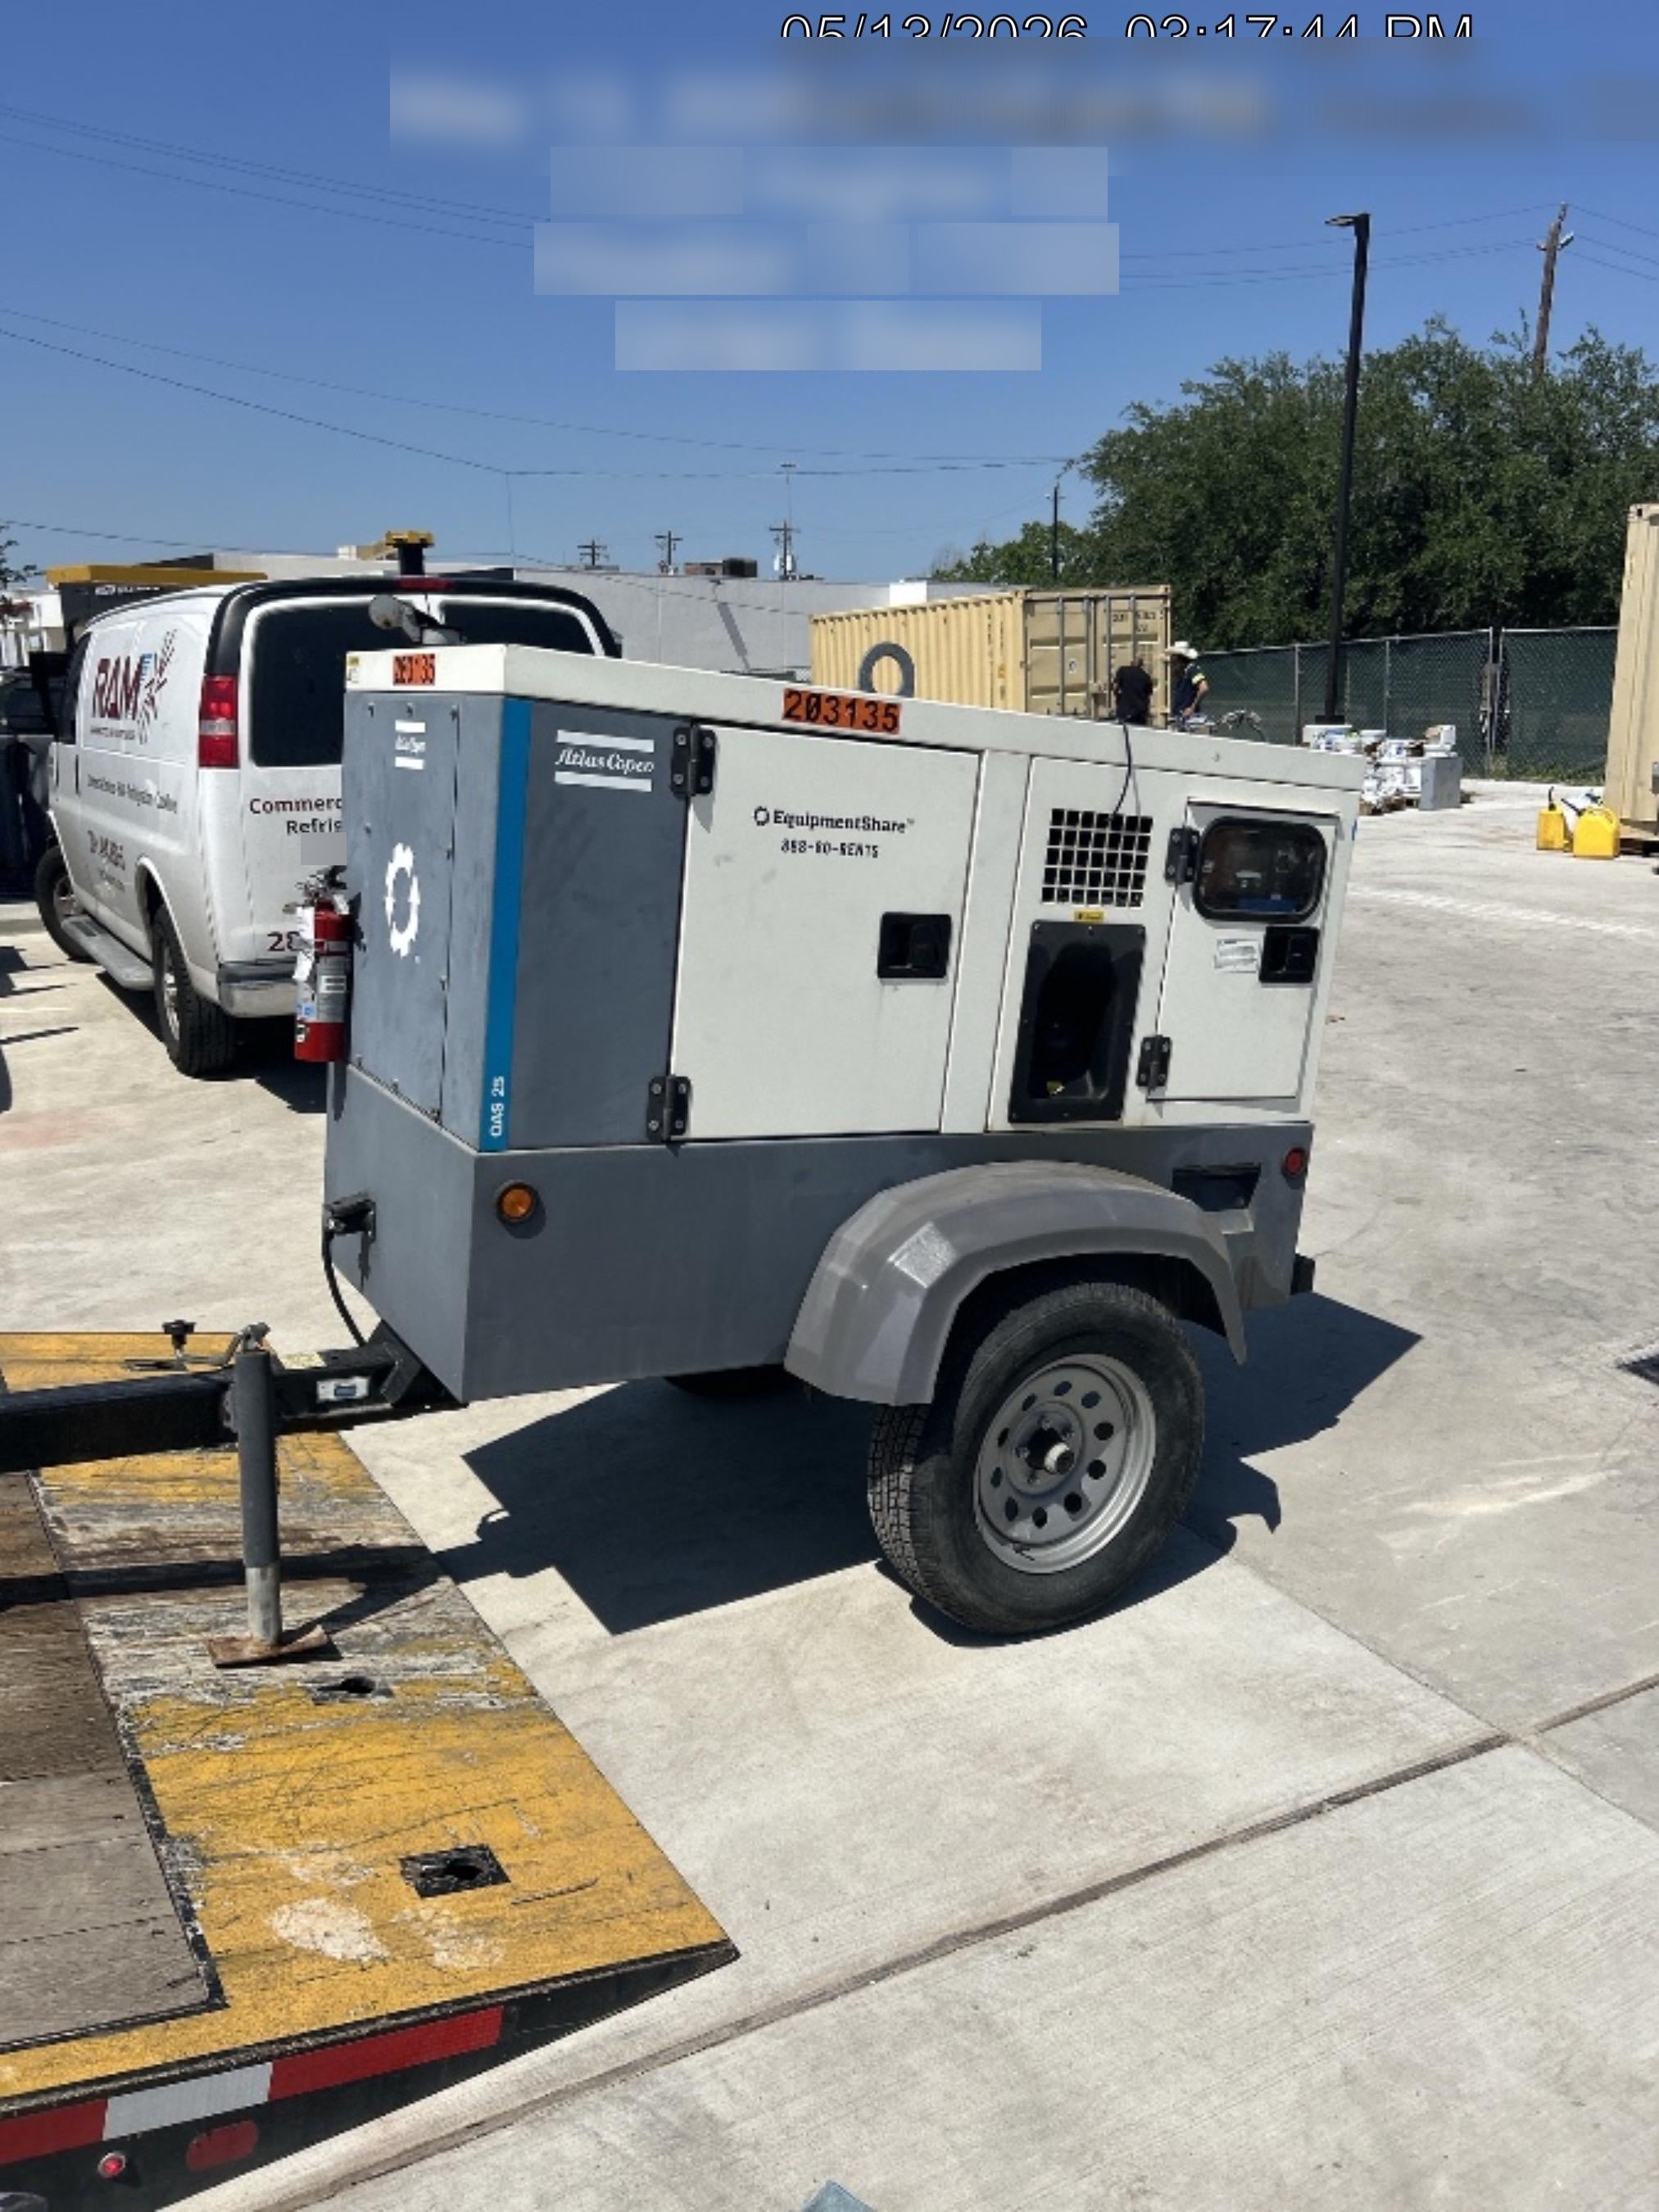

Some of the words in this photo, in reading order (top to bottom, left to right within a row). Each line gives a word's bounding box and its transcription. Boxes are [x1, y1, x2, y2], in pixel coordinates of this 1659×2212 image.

[782, 689, 900, 732] 203135
[555, 746, 605, 768] Atlas
[606, 752, 655, 775] Copco
[491, 1076, 505, 1097] 25
[490, 1102, 505, 1137] QAS
